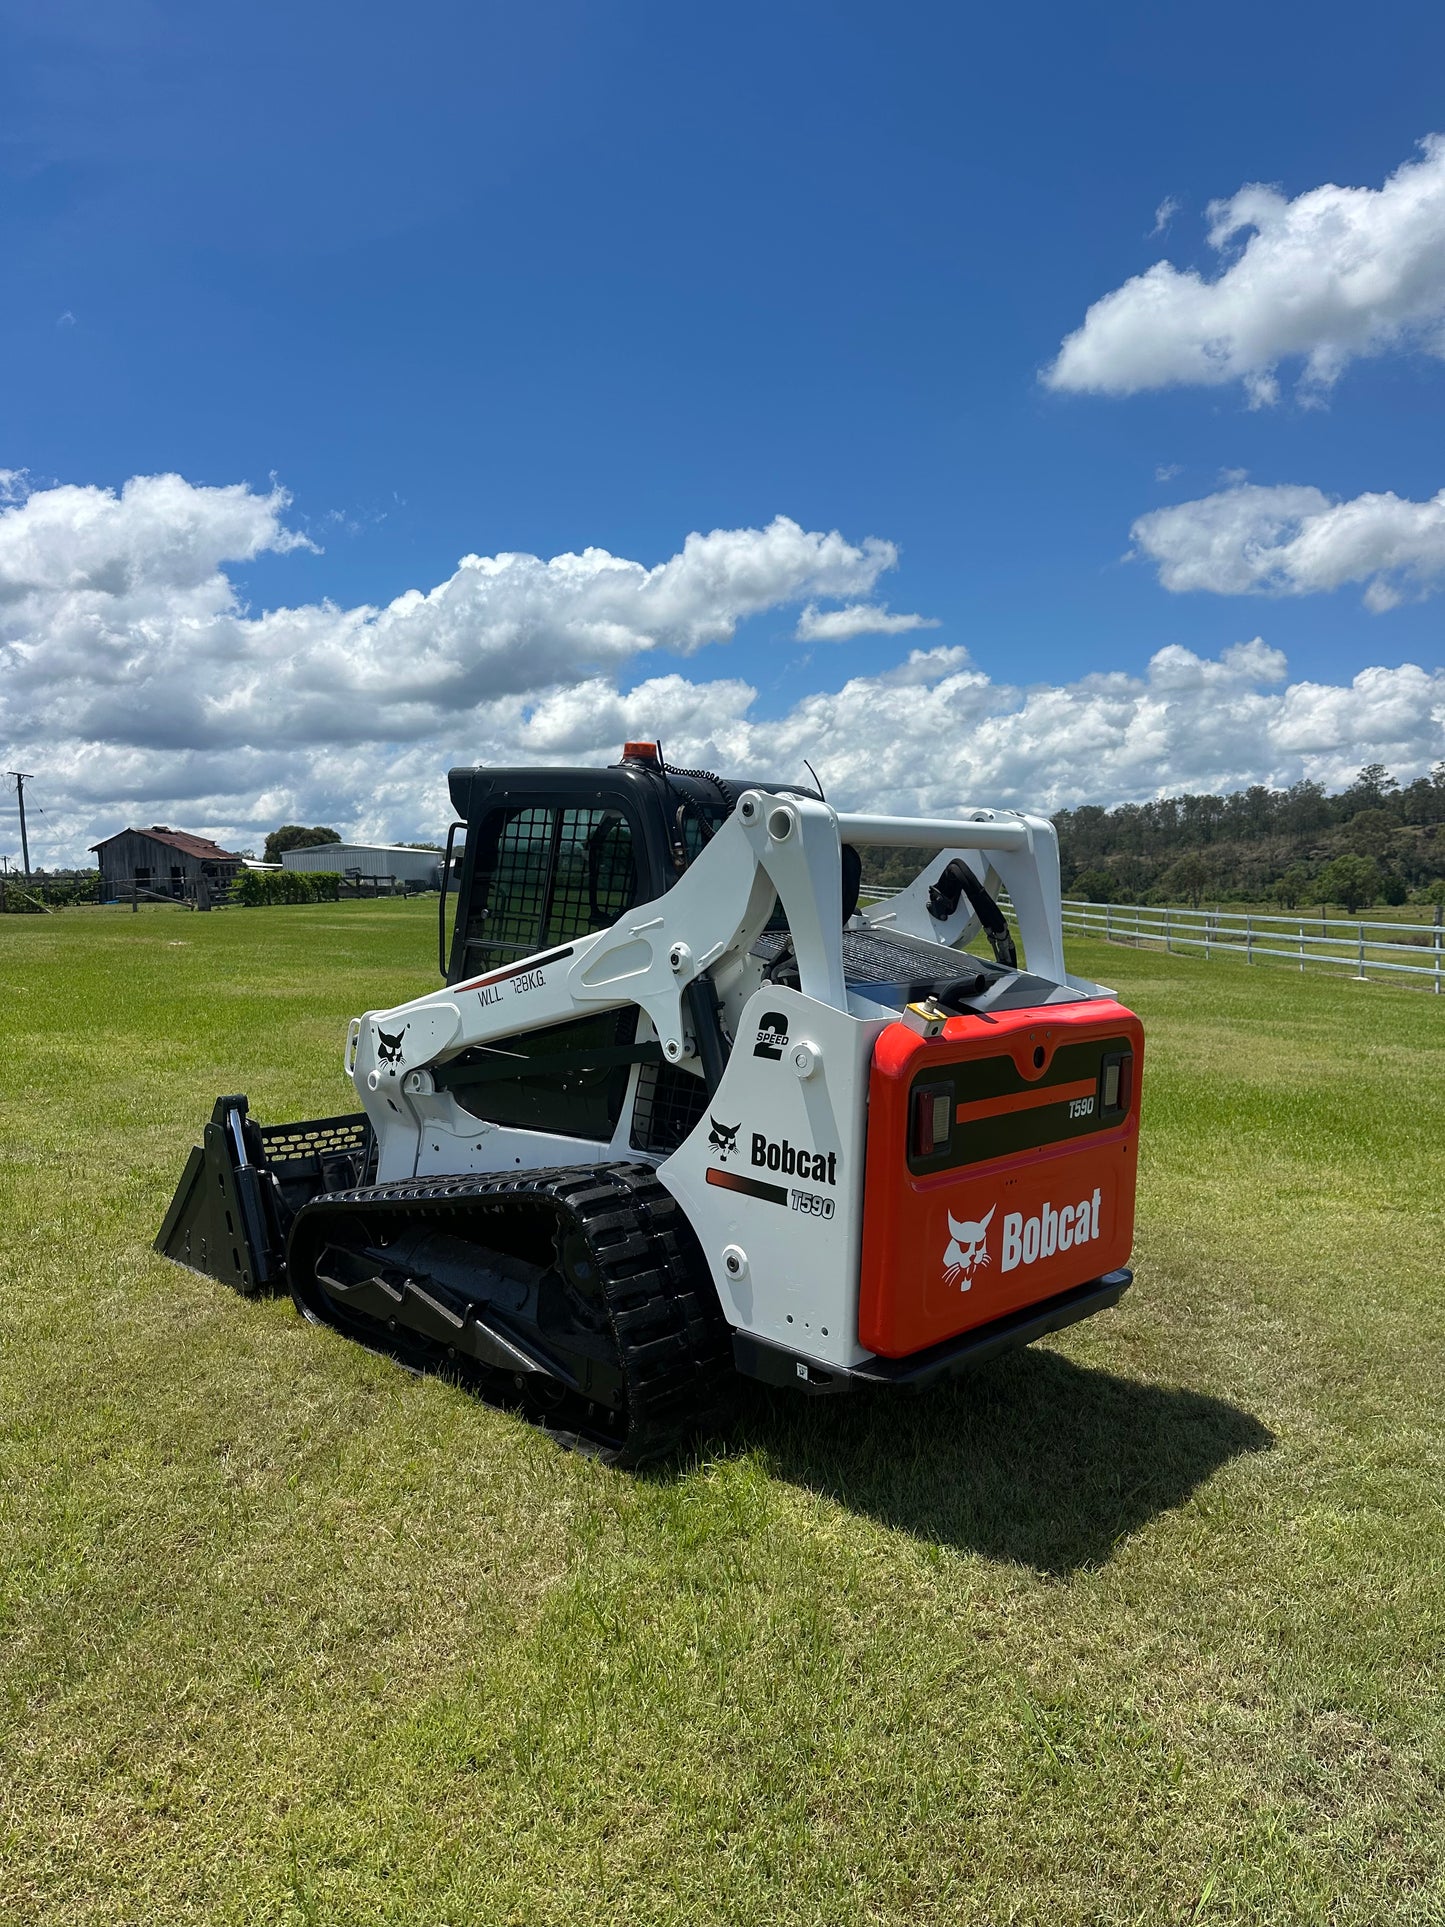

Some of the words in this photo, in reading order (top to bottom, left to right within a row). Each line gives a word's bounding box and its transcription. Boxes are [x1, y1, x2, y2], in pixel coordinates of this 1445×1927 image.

[753, 1011, 789, 1061] 2
[756, 1032, 789, 1046] SPEED
[1069, 1096, 1095, 1119] T590
[751, 1132, 837, 1186] Bobcat
[791, 1189, 836, 1220] T590
[1001, 1188, 1102, 1274] Bobcat
